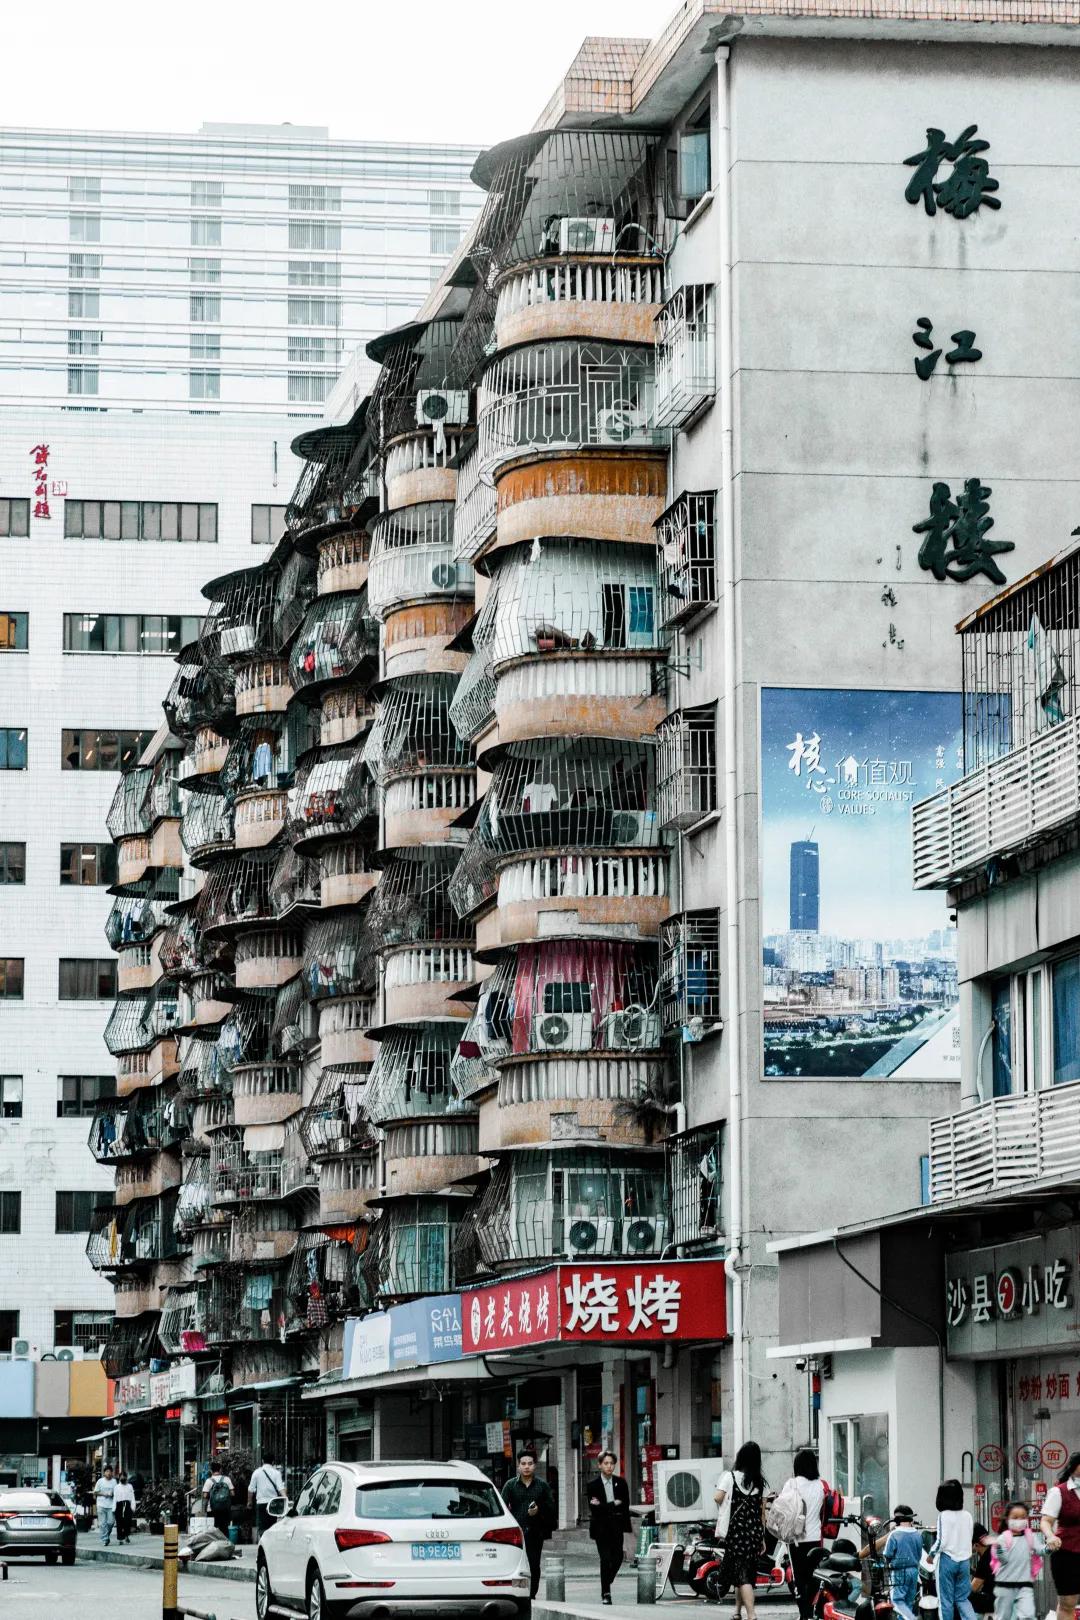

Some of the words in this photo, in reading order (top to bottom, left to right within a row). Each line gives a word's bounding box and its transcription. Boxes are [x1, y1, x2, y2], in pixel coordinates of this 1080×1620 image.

[837, 789, 862, 801] CORE
[865, 791, 915, 801] SOCIALIST
[837, 804, 876, 815] VALUES
[484, 1285, 550, 1340] 老头烧烤
[564, 1272, 682, 1334] 烧烤
[1045, 1372, 1070, 1399] 炒面
